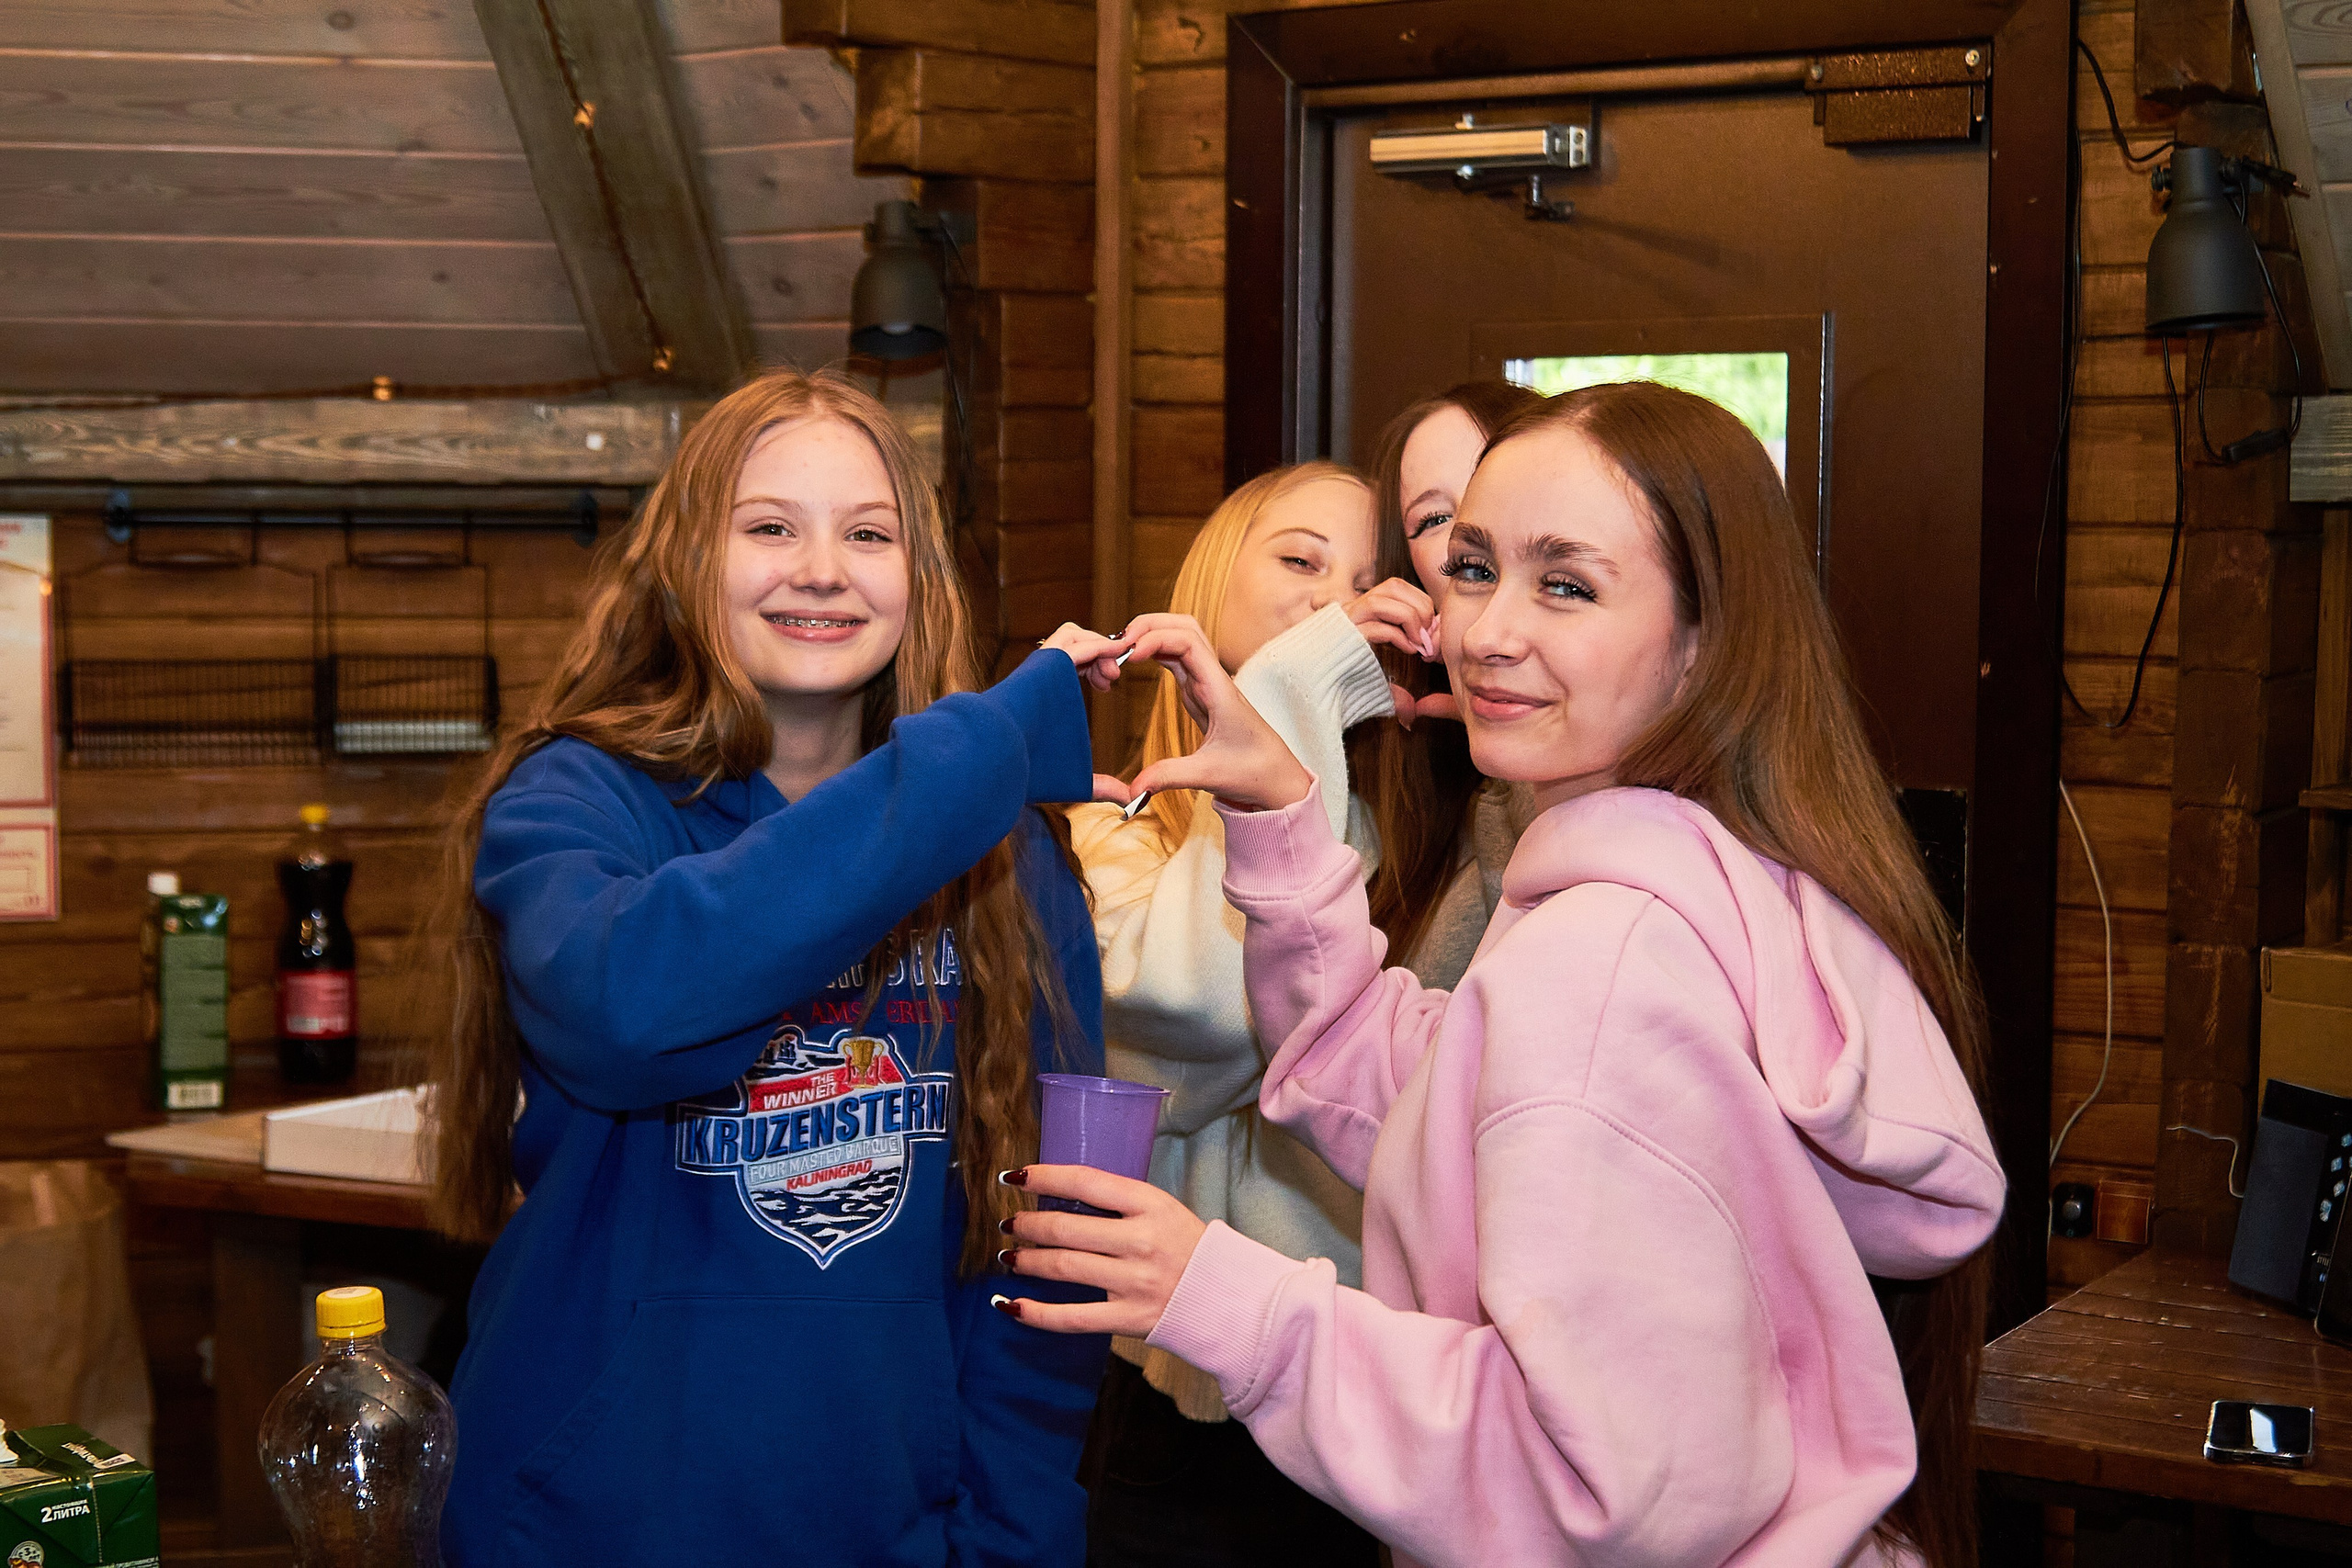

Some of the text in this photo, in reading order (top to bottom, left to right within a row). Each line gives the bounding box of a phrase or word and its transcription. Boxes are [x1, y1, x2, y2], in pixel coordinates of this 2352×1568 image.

[810, 1072, 835, 1087] THE
[763, 1082, 837, 1110] WINNER
[684, 1084, 946, 1165] KRUZENSTERN
[750, 1136, 899, 1182] FOUR MASTED BARQUE
[786, 1159, 873, 1191] KALININGRAD
[40, 1506, 52, 1523] 2
[52, 1505, 90, 1521] ЛИТРА
